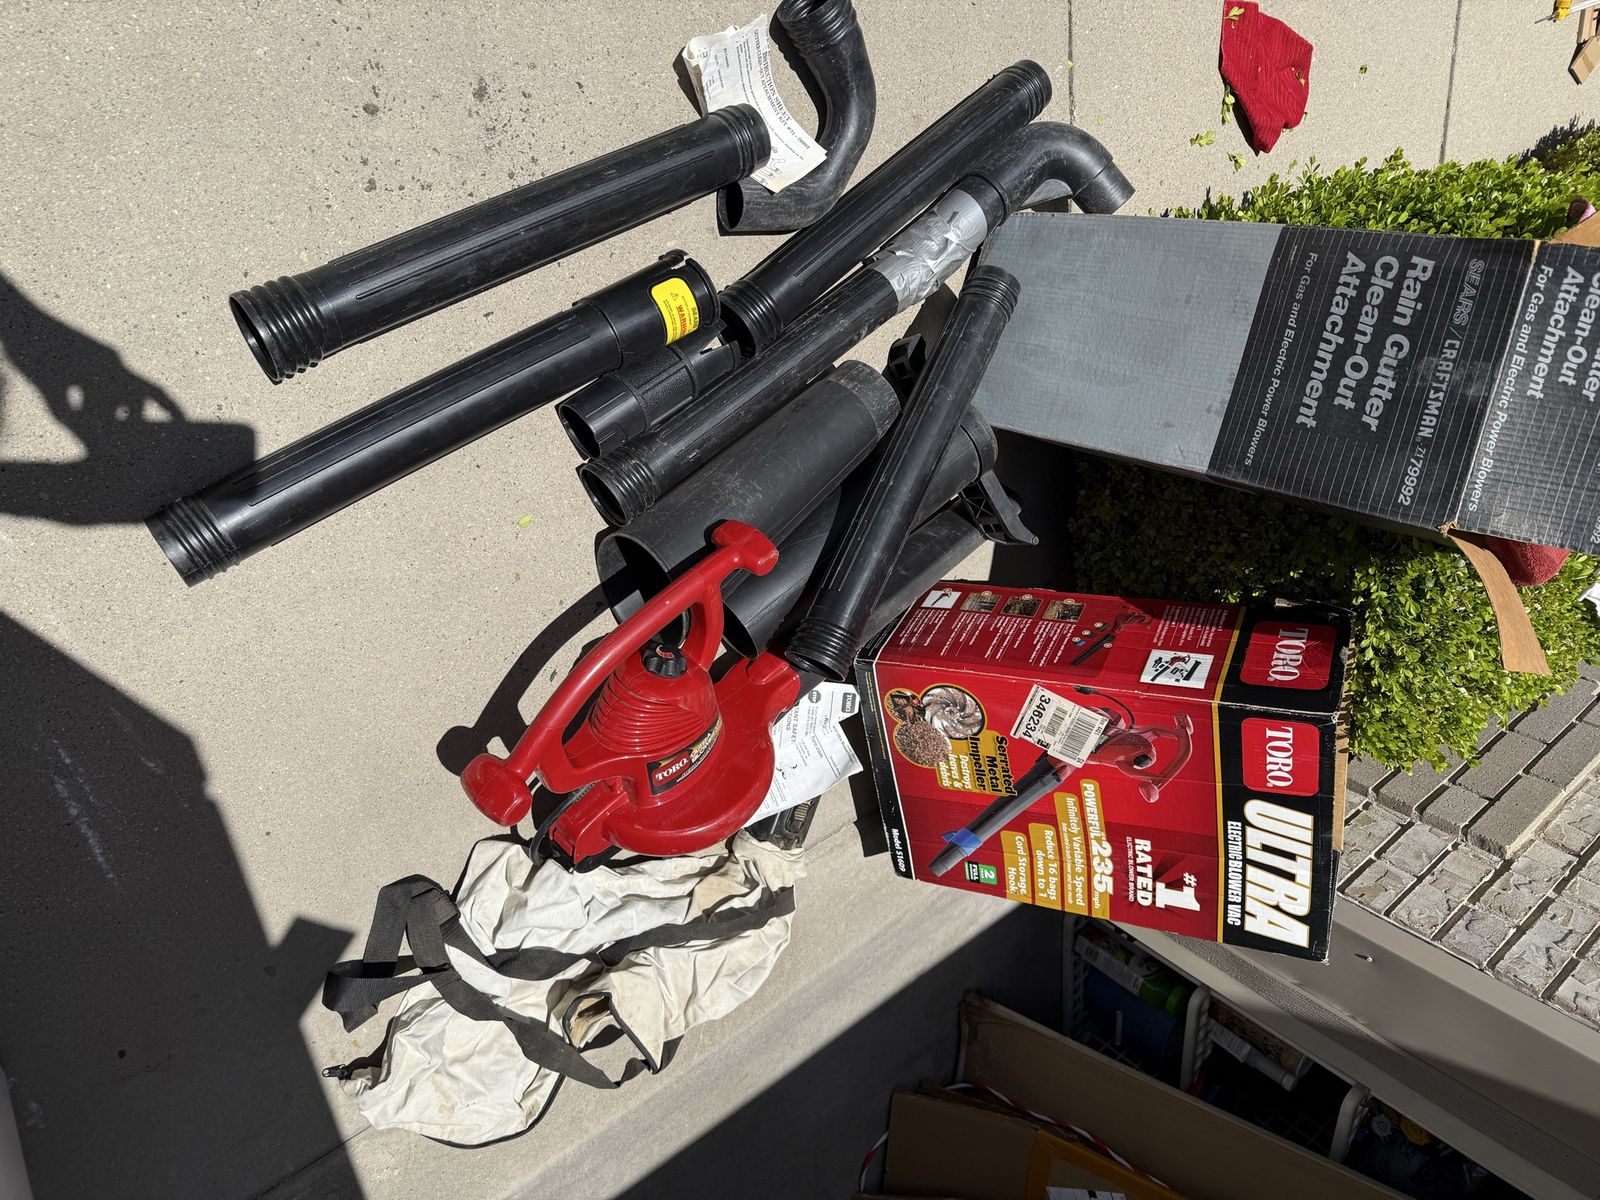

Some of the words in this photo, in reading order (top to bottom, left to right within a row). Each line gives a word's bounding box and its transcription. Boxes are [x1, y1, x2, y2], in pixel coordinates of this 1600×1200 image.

[1304, 252, 1319, 273] For
[1536, 265, 1554, 290] For
[1294, 274, 1313, 300] Gas
[1392, 256, 1436, 326] Rain
[1452, 259, 1484, 326] SEARS
[1286, 302, 1304, 326] and
[1524, 292, 1544, 321] Gas
[1295, 251, 1366, 428] Attachment
[1334, 255, 1400, 409] Clean-Out
[1516, 324, 1534, 351] and
[1526, 266, 1584, 400] Attachment
[1272, 328, 1297, 376] Electric
[1261, 378, 1282, 416] Power
[1361, 333, 1411, 432] Gutter
[1415, 340, 1460, 438] CRAFTSMAN
[1498, 354, 1524, 408] Electric
[1244, 418, 1269, 466] Blowers
[1486, 411, 1508, 456] Power
[1468, 458, 1494, 512] Blowers
[1266, 628, 1308, 681] TORO
[1021, 694, 1051, 739] 346234
[938, 762, 950, 787] debris
[948, 754, 959, 780] leaves
[959, 755, 971, 789] Destroys
[969, 736, 986, 791] Impeller
[986, 756, 1002, 792] Metal
[996, 736, 1017, 795] Serrated
[1265, 726, 1293, 787] TORO
[1066, 797, 1080, 834] Infinitely
[1082, 783, 1102, 839] POWERFUL
[891, 829, 902, 850] Model
[1016, 836, 1027, 855] Cord
[1044, 830, 1056, 859] Reduce
[1072, 836, 1084, 872] Variable
[1227, 821, 1242, 859] ELECTRIC
[984, 870, 995, 879] 2
[1036, 850, 1047, 875] down
[1048, 863, 1057, 874] 16
[1091, 840, 1113, 895] 235
[1135, 838, 1152, 906] RATED
[1228, 860, 1242, 902] BLOWER
[1243, 799, 1314, 948] ULTRA
[1038, 878, 1047, 888] to
[1048, 877, 1058, 900] bags
[1074, 876, 1085, 906] Speed
[1155, 872, 1200, 912] #1
[1227, 904, 1240, 926] VAC
